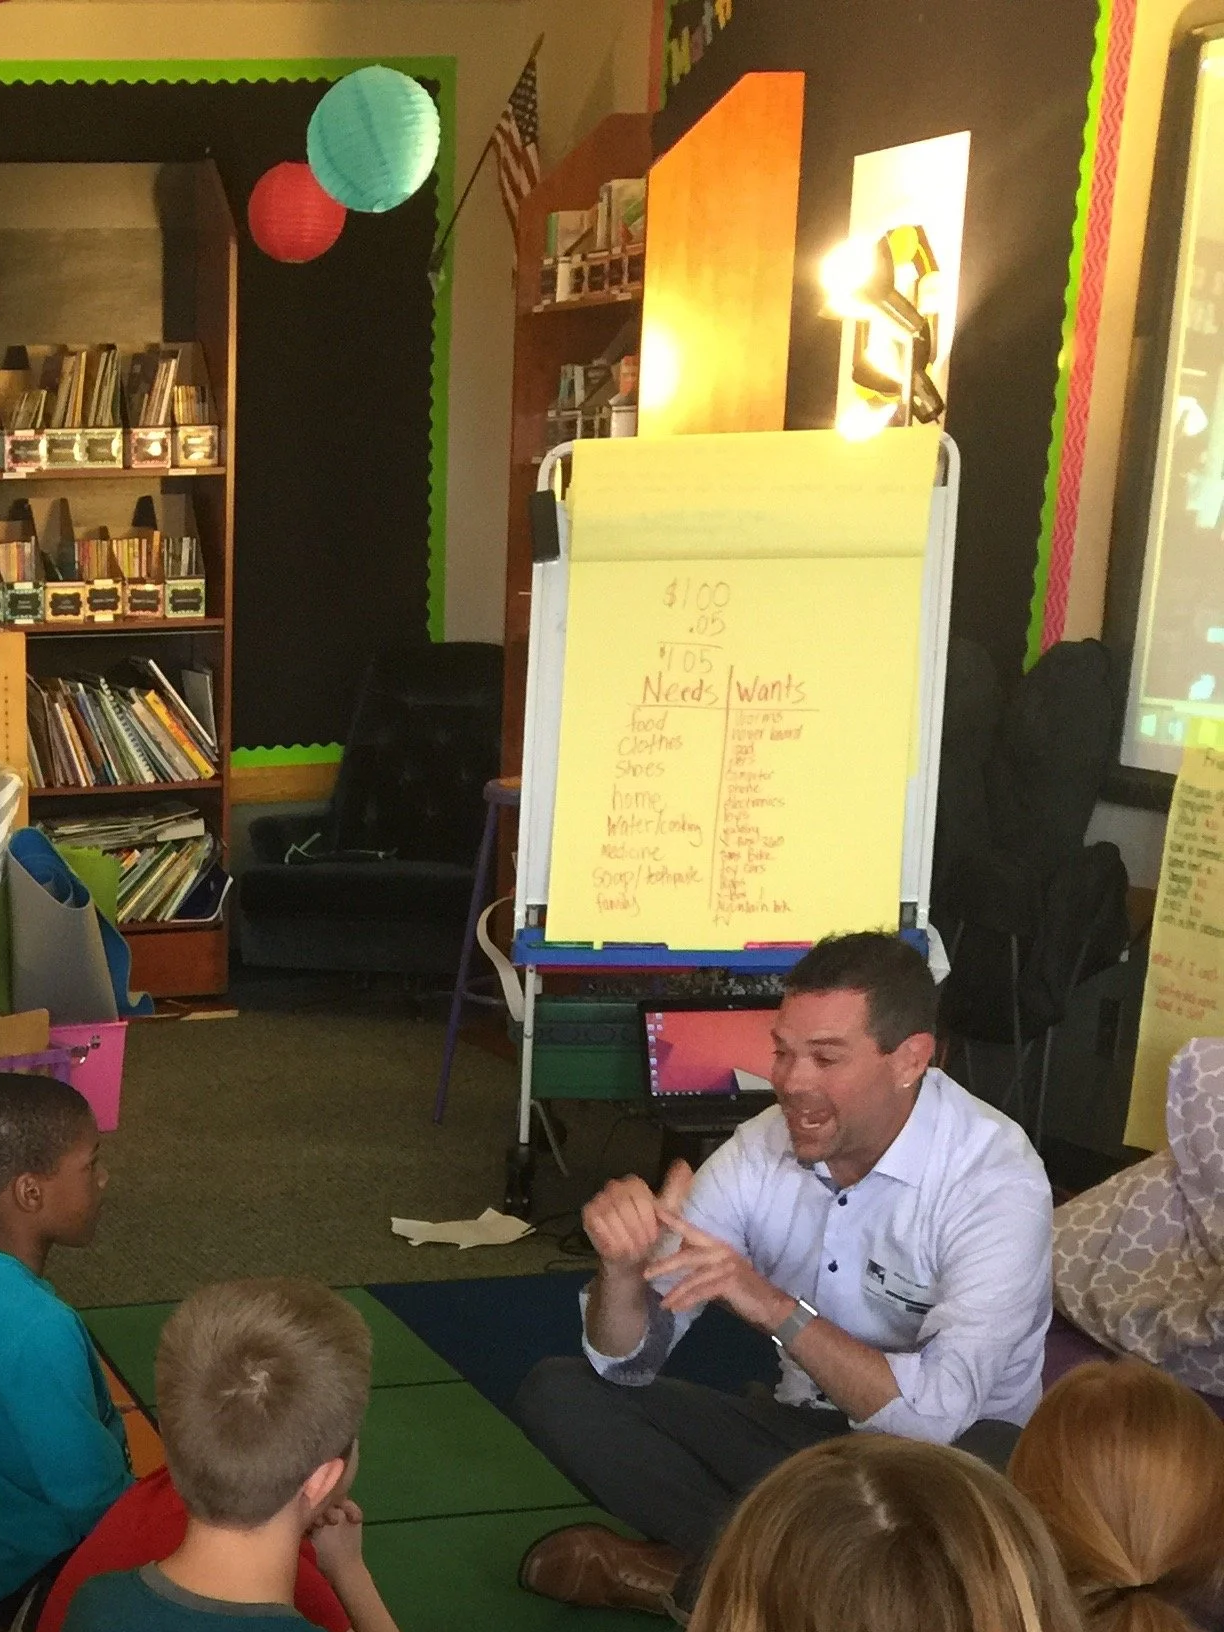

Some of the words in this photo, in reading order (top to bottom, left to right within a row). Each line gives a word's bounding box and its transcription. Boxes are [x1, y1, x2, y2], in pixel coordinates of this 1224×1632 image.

[662, 577, 731, 611] $100
[688, 611, 726, 637] .05
[642, 671, 720, 706] Needs
[736, 673, 807, 705] Wants
[627, 709, 668, 734] food
